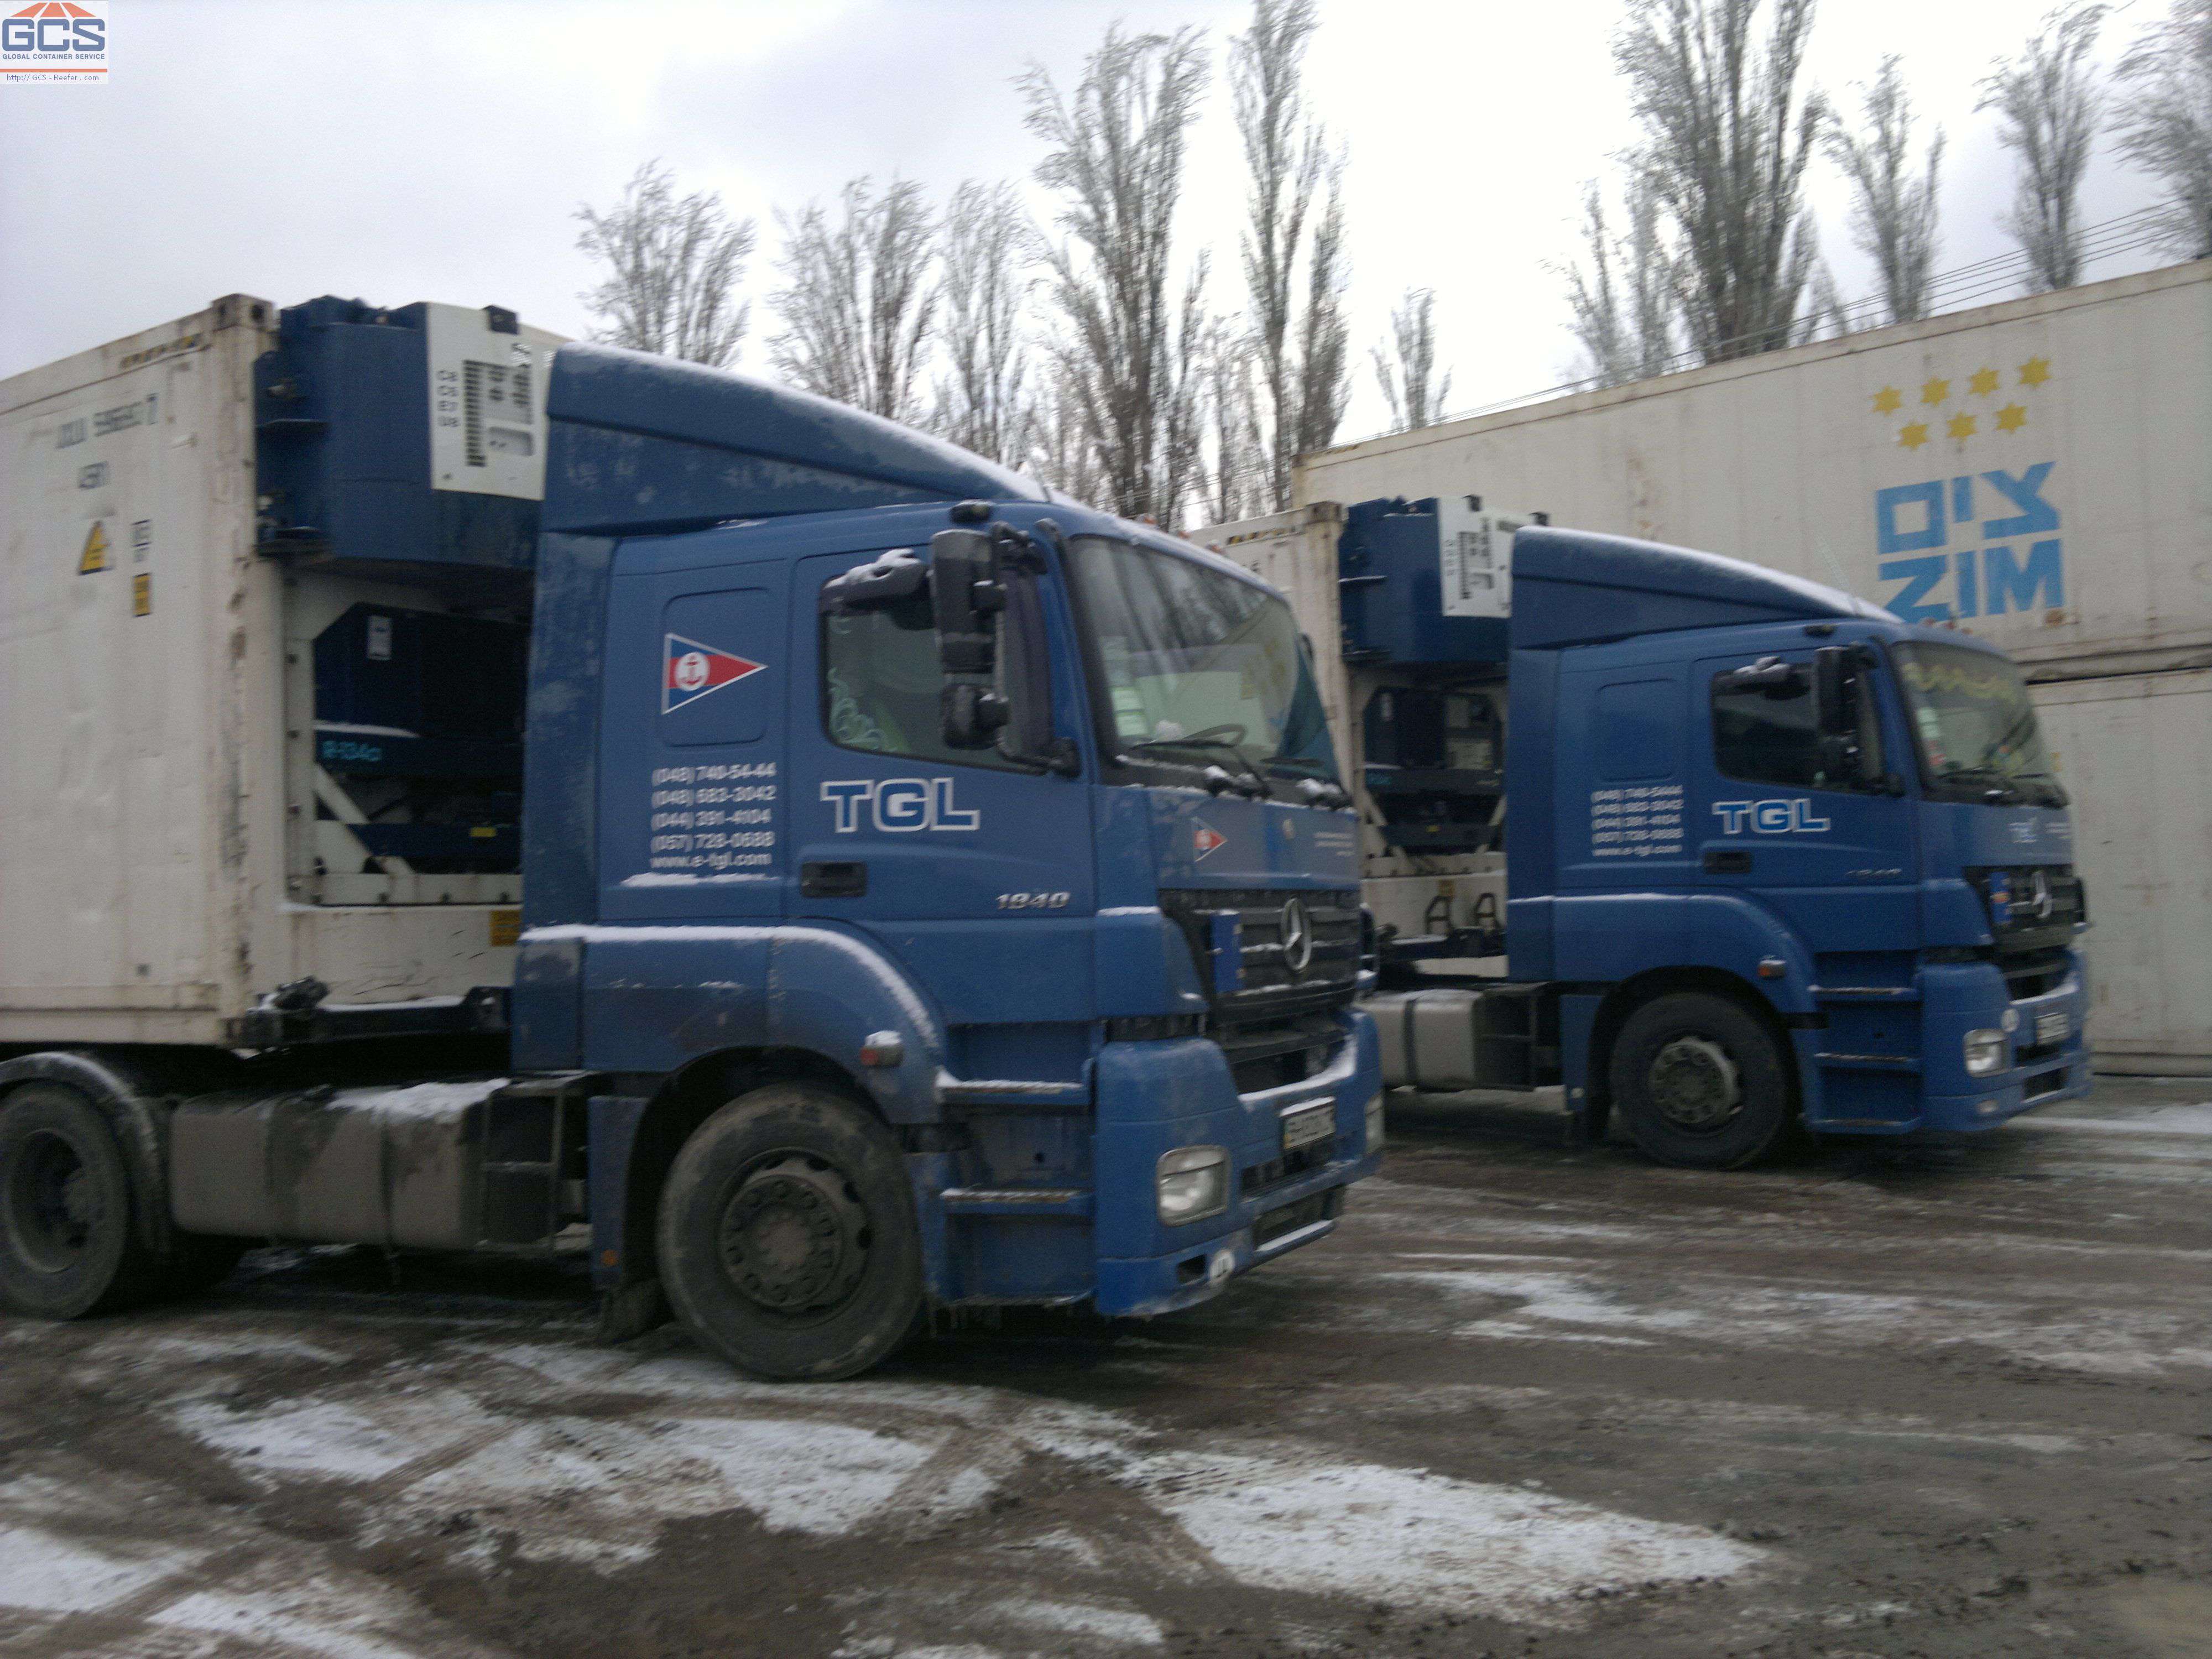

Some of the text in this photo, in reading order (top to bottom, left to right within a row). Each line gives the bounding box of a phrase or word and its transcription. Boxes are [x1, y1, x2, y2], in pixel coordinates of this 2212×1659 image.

[1878, 538, 2065, 624] ZIM
[820, 777, 980, 833] TGL
[1712, 798, 1830, 834] TGL
